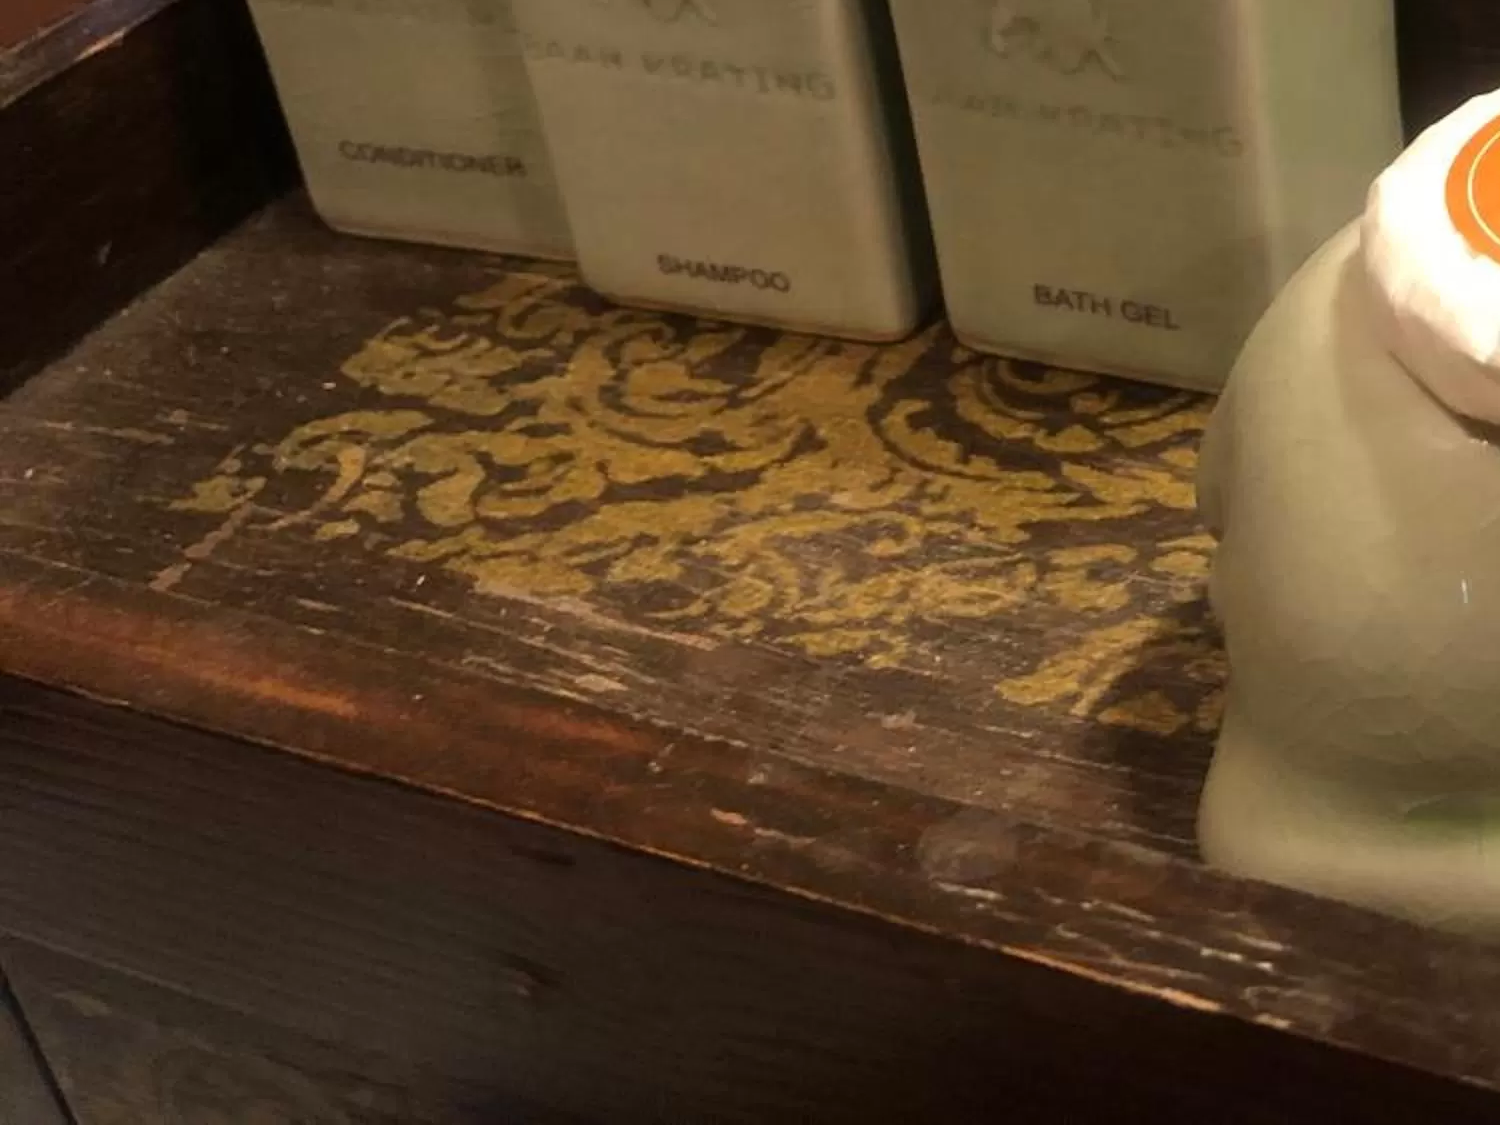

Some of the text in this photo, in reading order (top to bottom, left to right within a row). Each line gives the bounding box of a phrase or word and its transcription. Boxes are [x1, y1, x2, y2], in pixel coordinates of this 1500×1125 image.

[338, 139, 528, 178] CONDITIONER
[655, 253, 792, 294] SHAMPOO
[1032, 281, 1181, 332] BATH GEL
